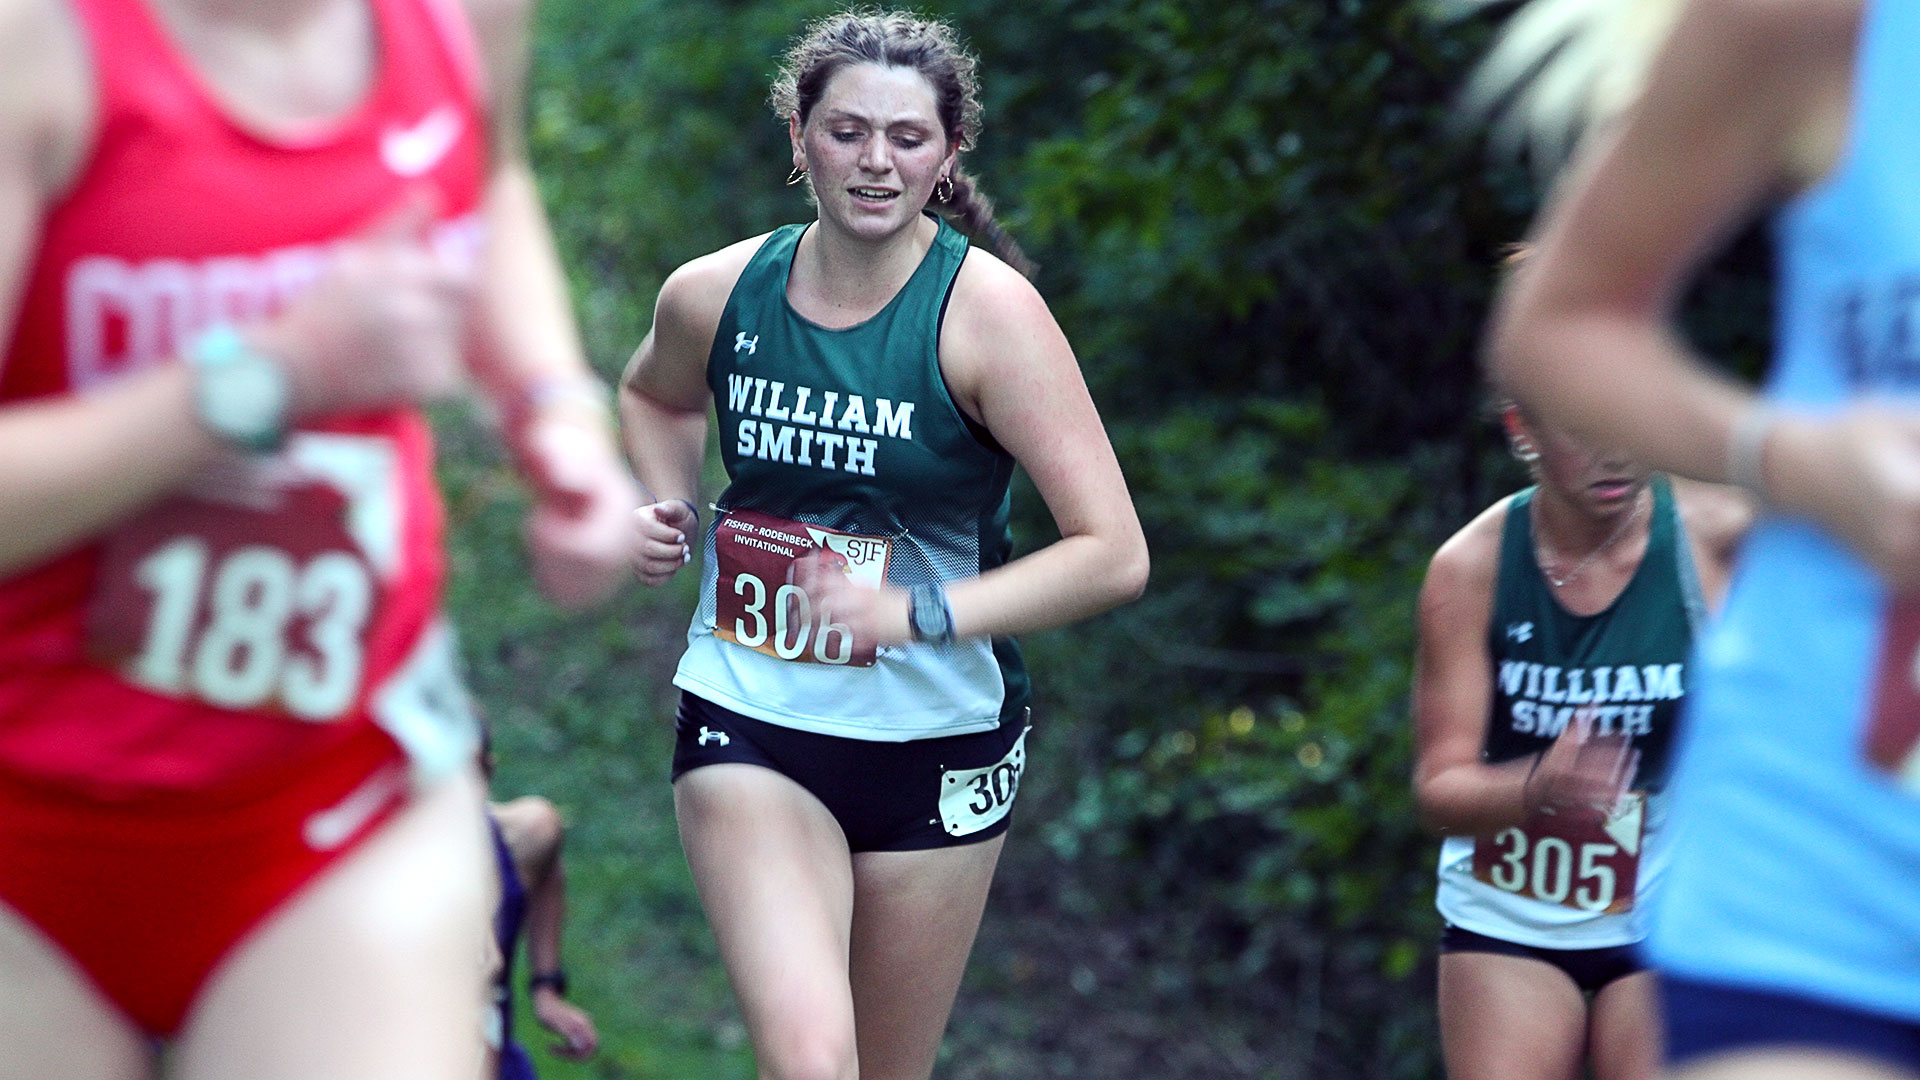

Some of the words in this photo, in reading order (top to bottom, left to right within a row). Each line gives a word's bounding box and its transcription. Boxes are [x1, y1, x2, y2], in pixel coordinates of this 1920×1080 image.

[728, 373, 915, 440] WILLIAM
[737, 419, 878, 477] SMITH
[724, 518, 754, 533] FISHER
[758, 527, 814, 549] RODENBECK
[734, 533, 795, 558] INVITATIONAL
[846, 539, 885, 566] SJF
[130, 538, 369, 719] 183
[1500, 661, 1684, 703] WILLIAM
[966, 762, 1020, 815] 30
[1491, 827, 1618, 912] 305
